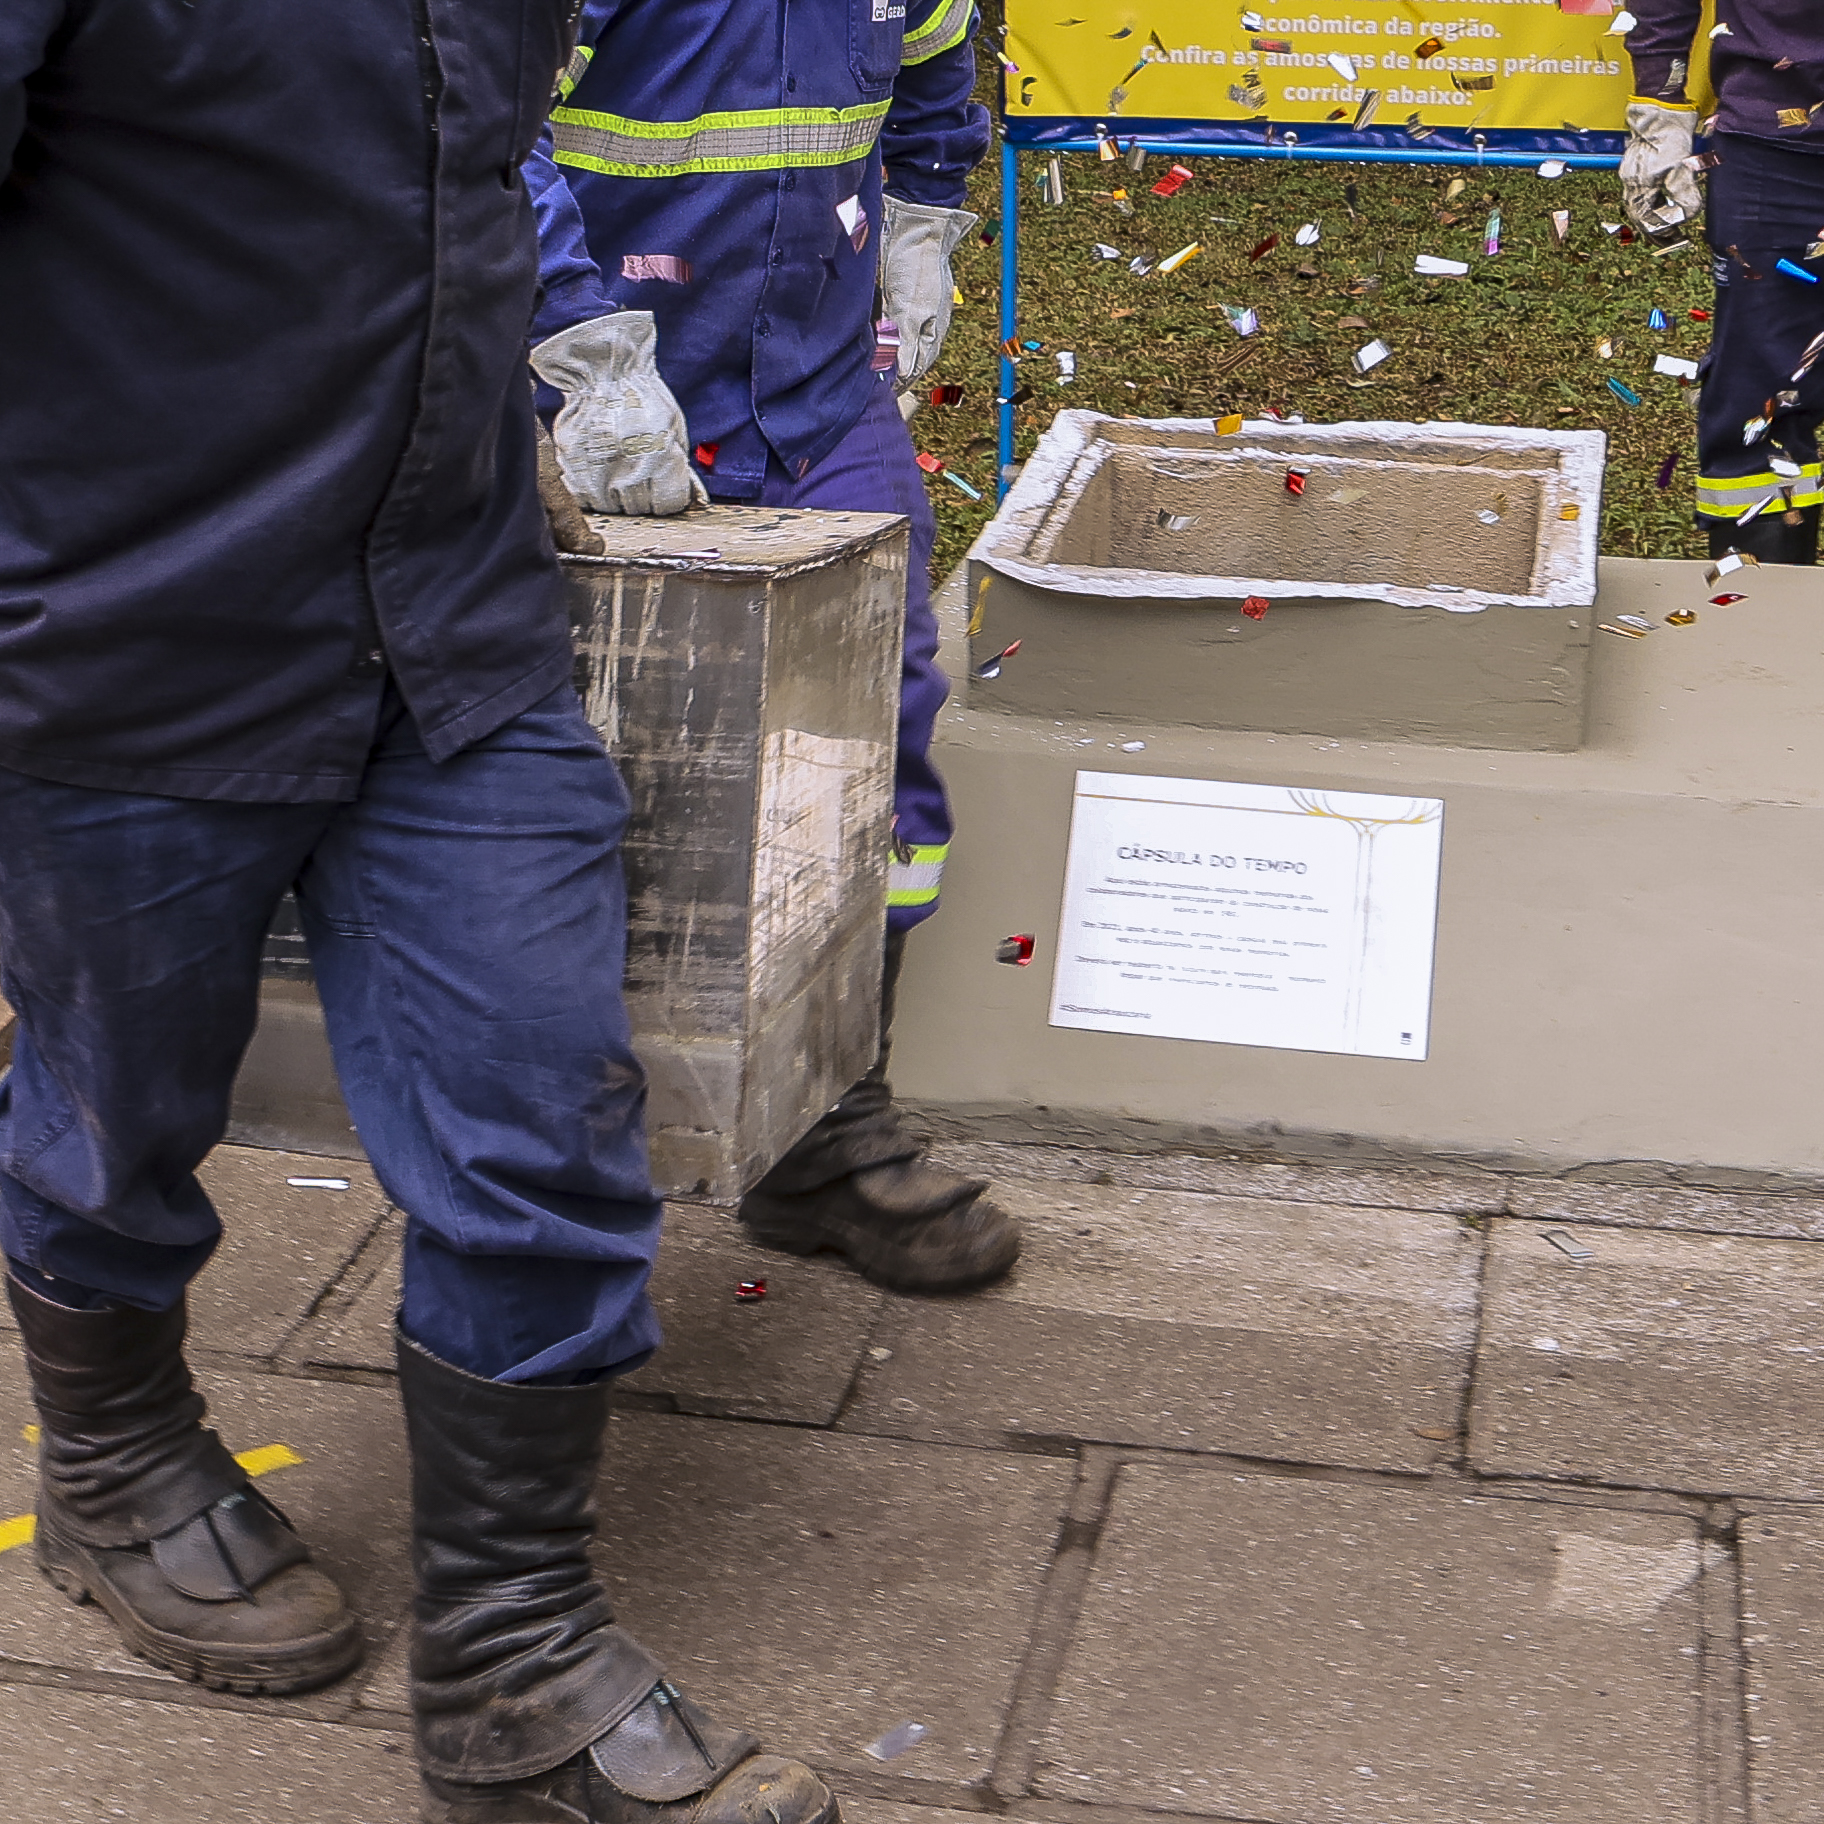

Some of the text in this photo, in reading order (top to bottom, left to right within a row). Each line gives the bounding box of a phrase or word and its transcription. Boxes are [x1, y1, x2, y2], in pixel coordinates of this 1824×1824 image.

[1252, 15, 1501, 41] conômica da região.
[1233, 50, 1258, 65] as
[1265, 53, 1375, 68] amosas
[1381, 51, 1410, 69] de
[1504, 54, 1619, 77] primeiras
[1283, 83, 1473, 105] corrida abaixo:
[1116, 843, 1307, 875] CÁPSULA DO TEMPO
